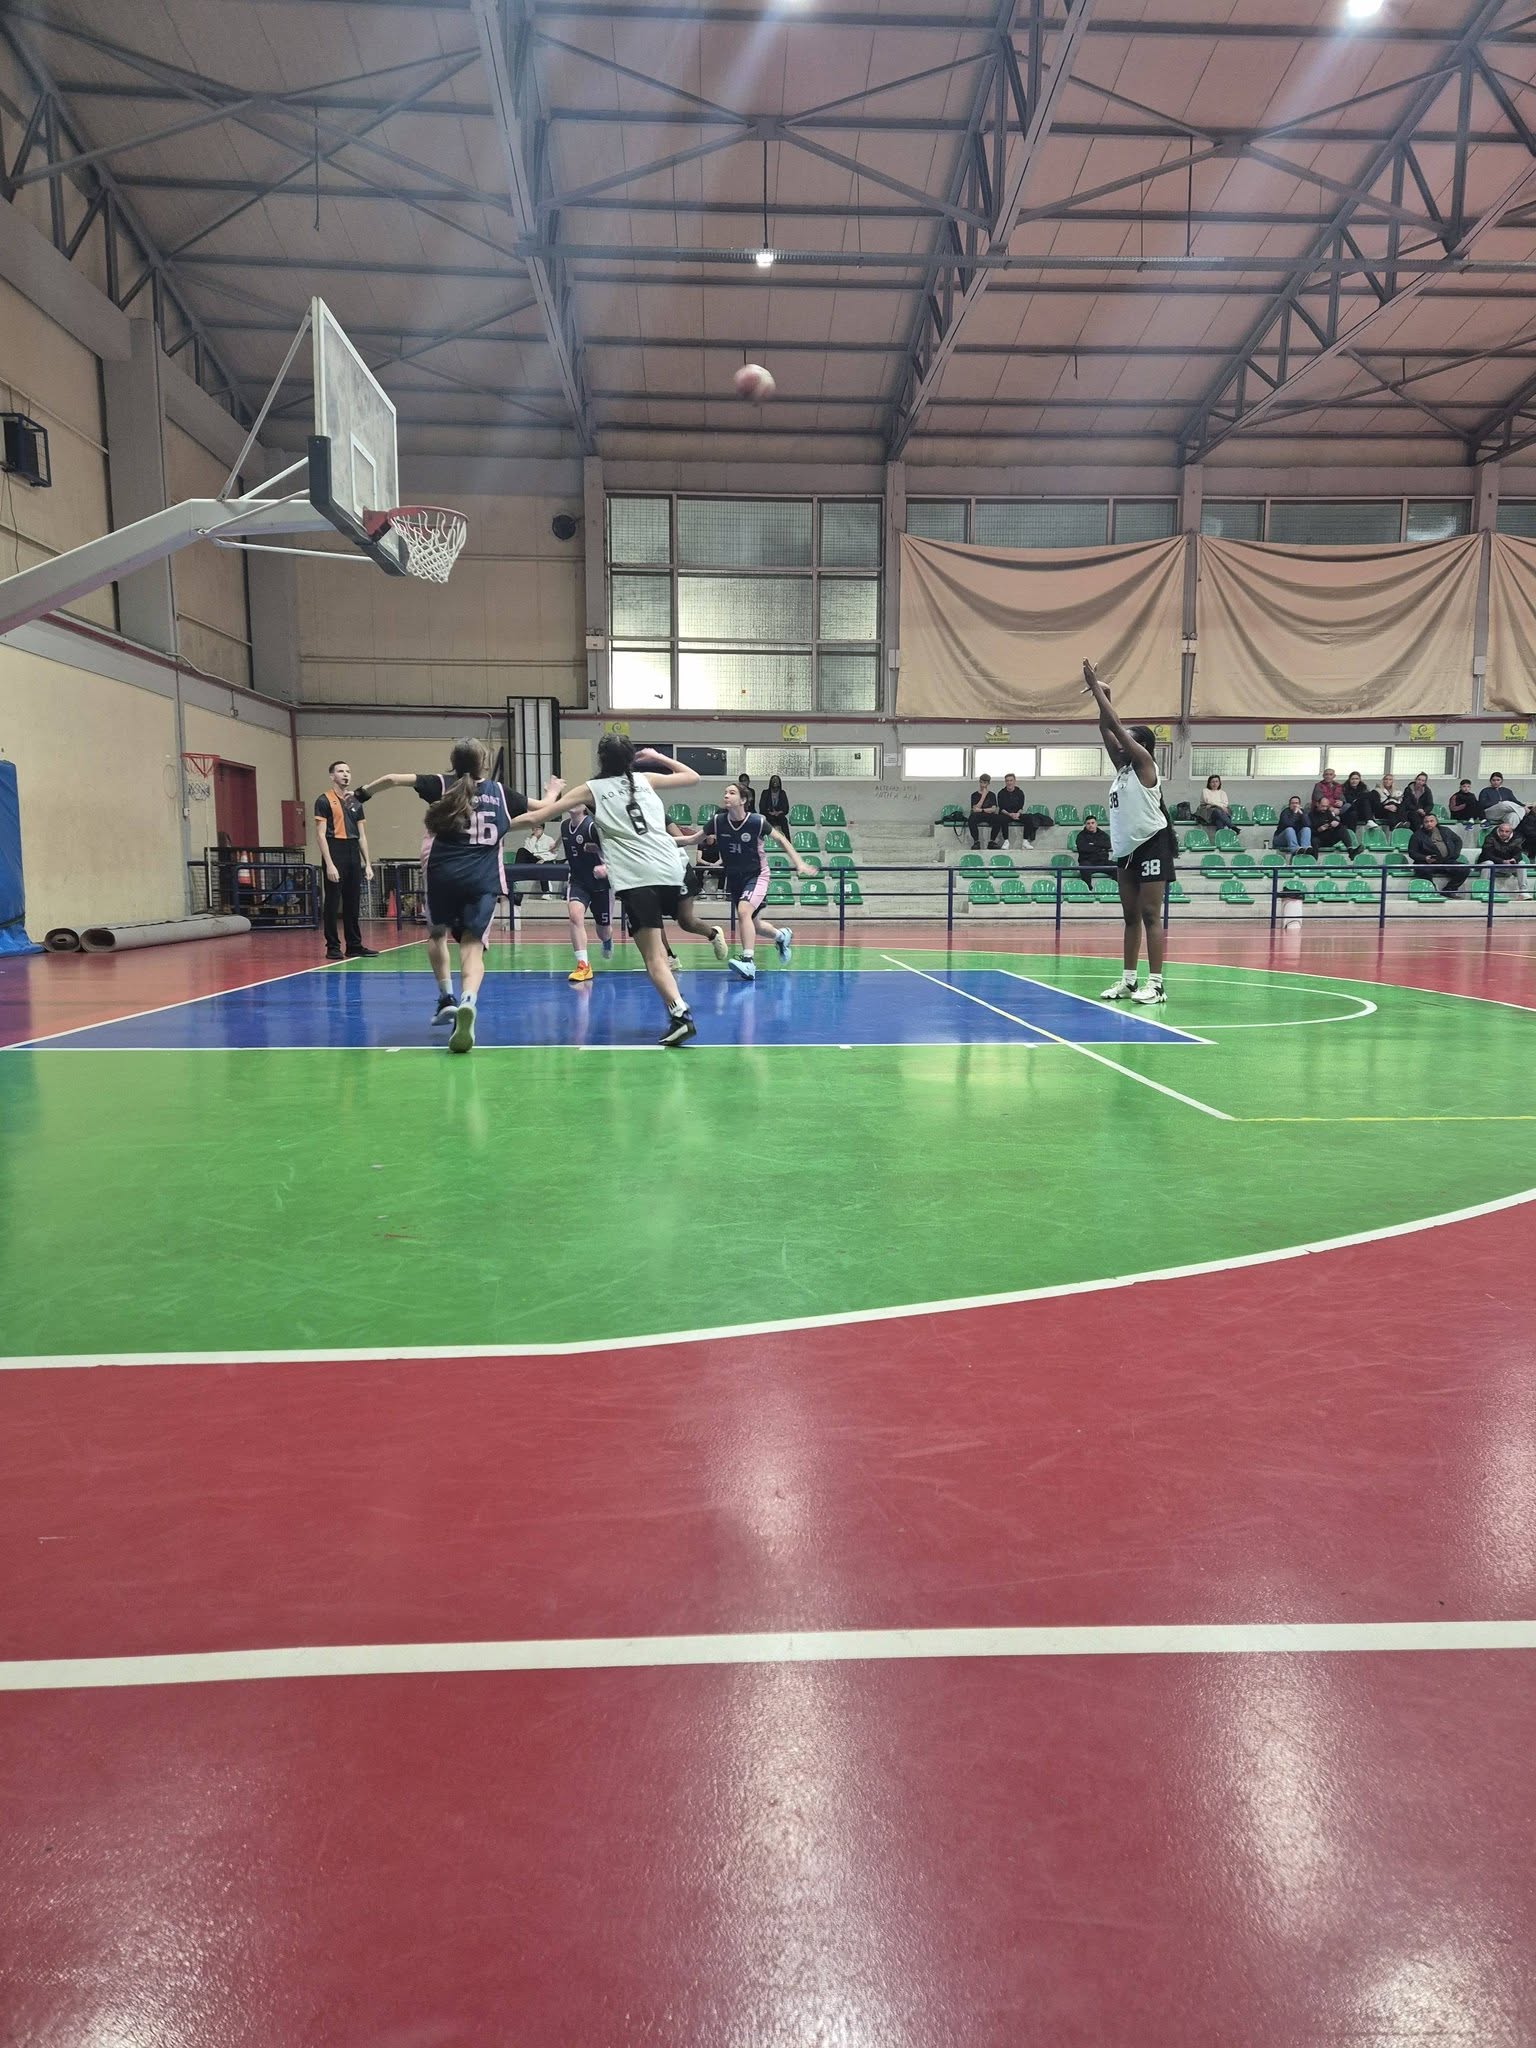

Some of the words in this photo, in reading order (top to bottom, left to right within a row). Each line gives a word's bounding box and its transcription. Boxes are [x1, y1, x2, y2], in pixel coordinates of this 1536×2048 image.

[571, 846, 579, 857] 5
[728, 843, 742, 854] 34
[1141, 859, 1161, 877] 38
[601, 912, 610, 923] 5
